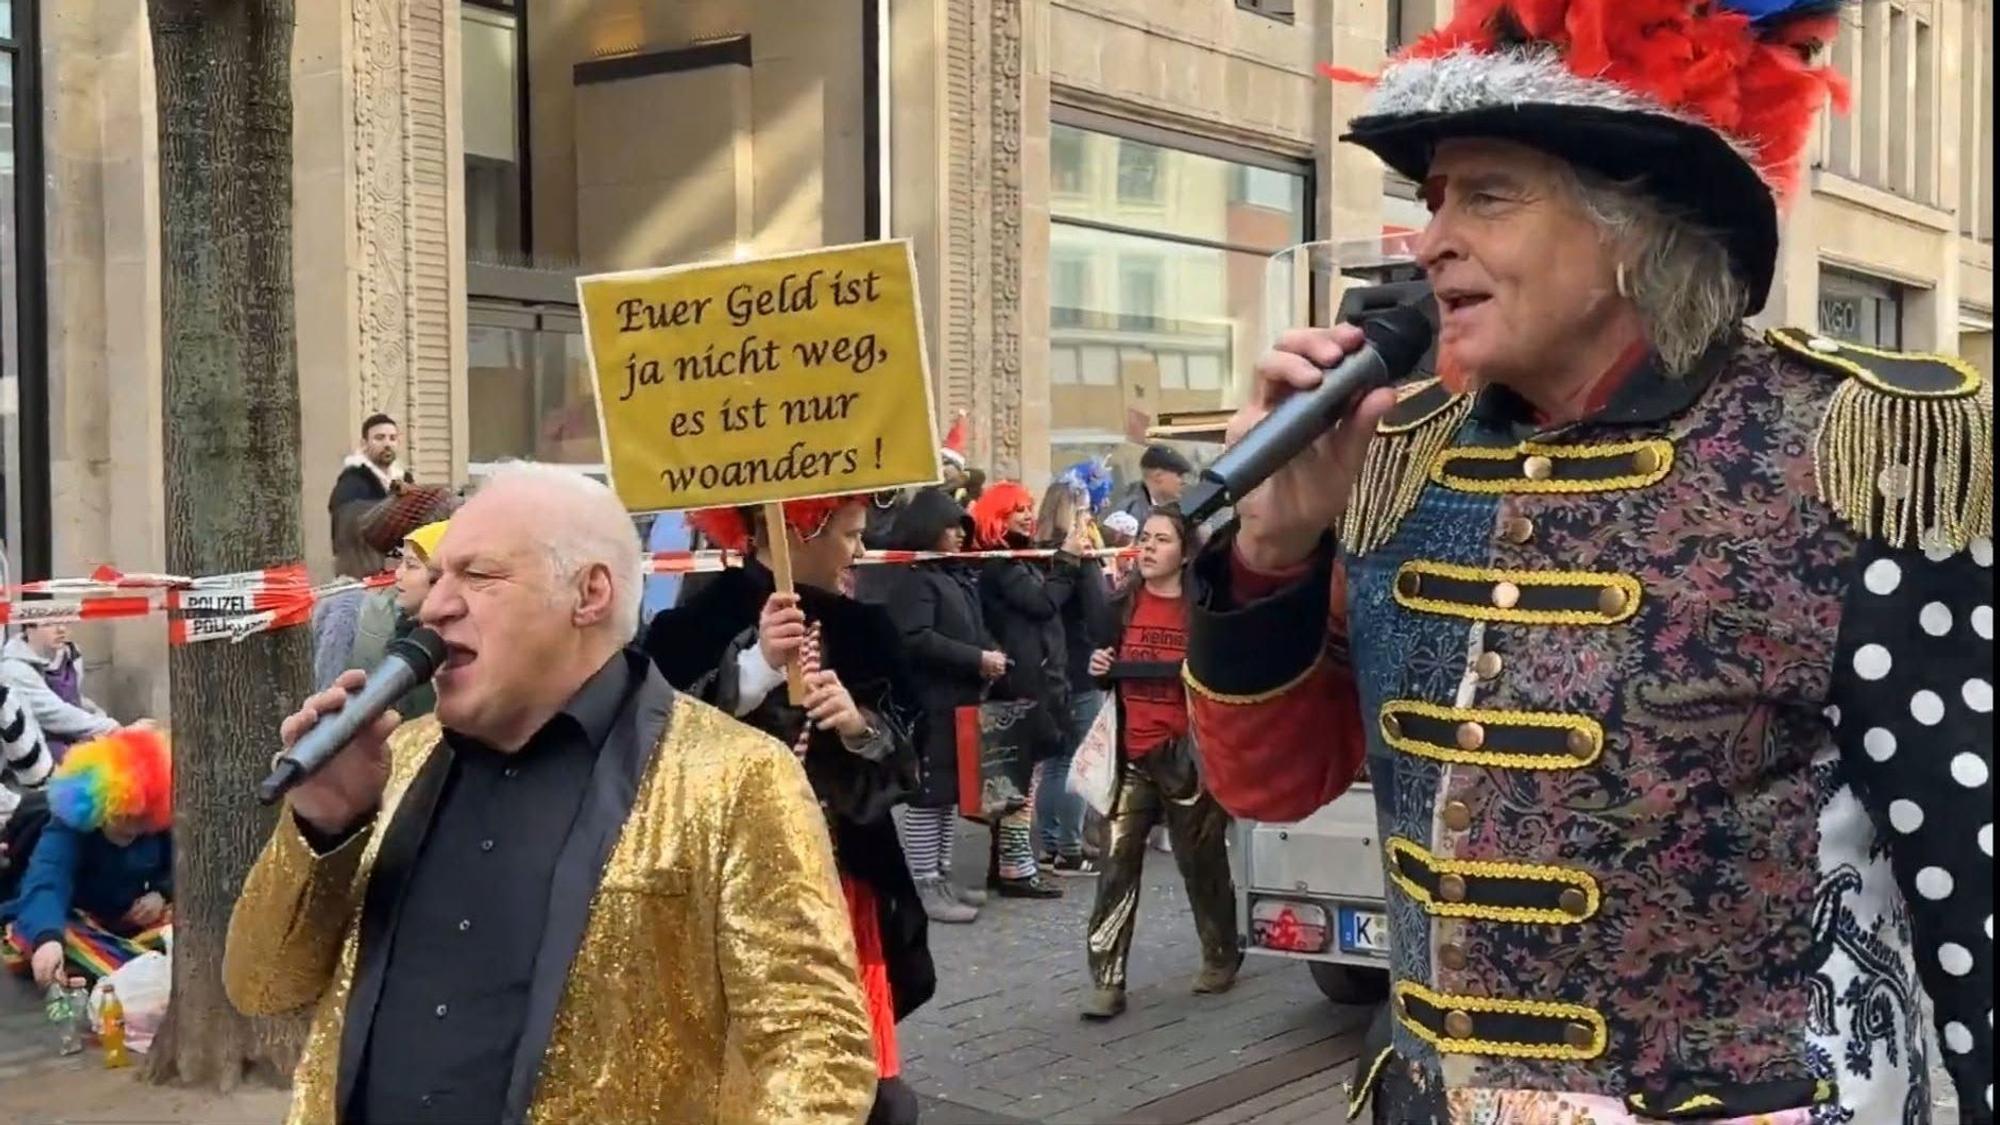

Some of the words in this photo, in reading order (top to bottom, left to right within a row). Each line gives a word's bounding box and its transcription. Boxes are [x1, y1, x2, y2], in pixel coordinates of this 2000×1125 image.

[614, 296, 713, 334] Euer
[725, 269, 825, 329] Geld
[828, 269, 882, 308] ist
[618, 351, 664, 403] ja
[672, 334, 782, 383] nicht
[791, 332, 889, 375] weg,
[669, 409, 706, 439] es
[718, 396, 769, 434] ist
[778, 391, 861, 427] nur
[660, 441, 859, 494] woanders
[1355, 915, 1372, 945] K
